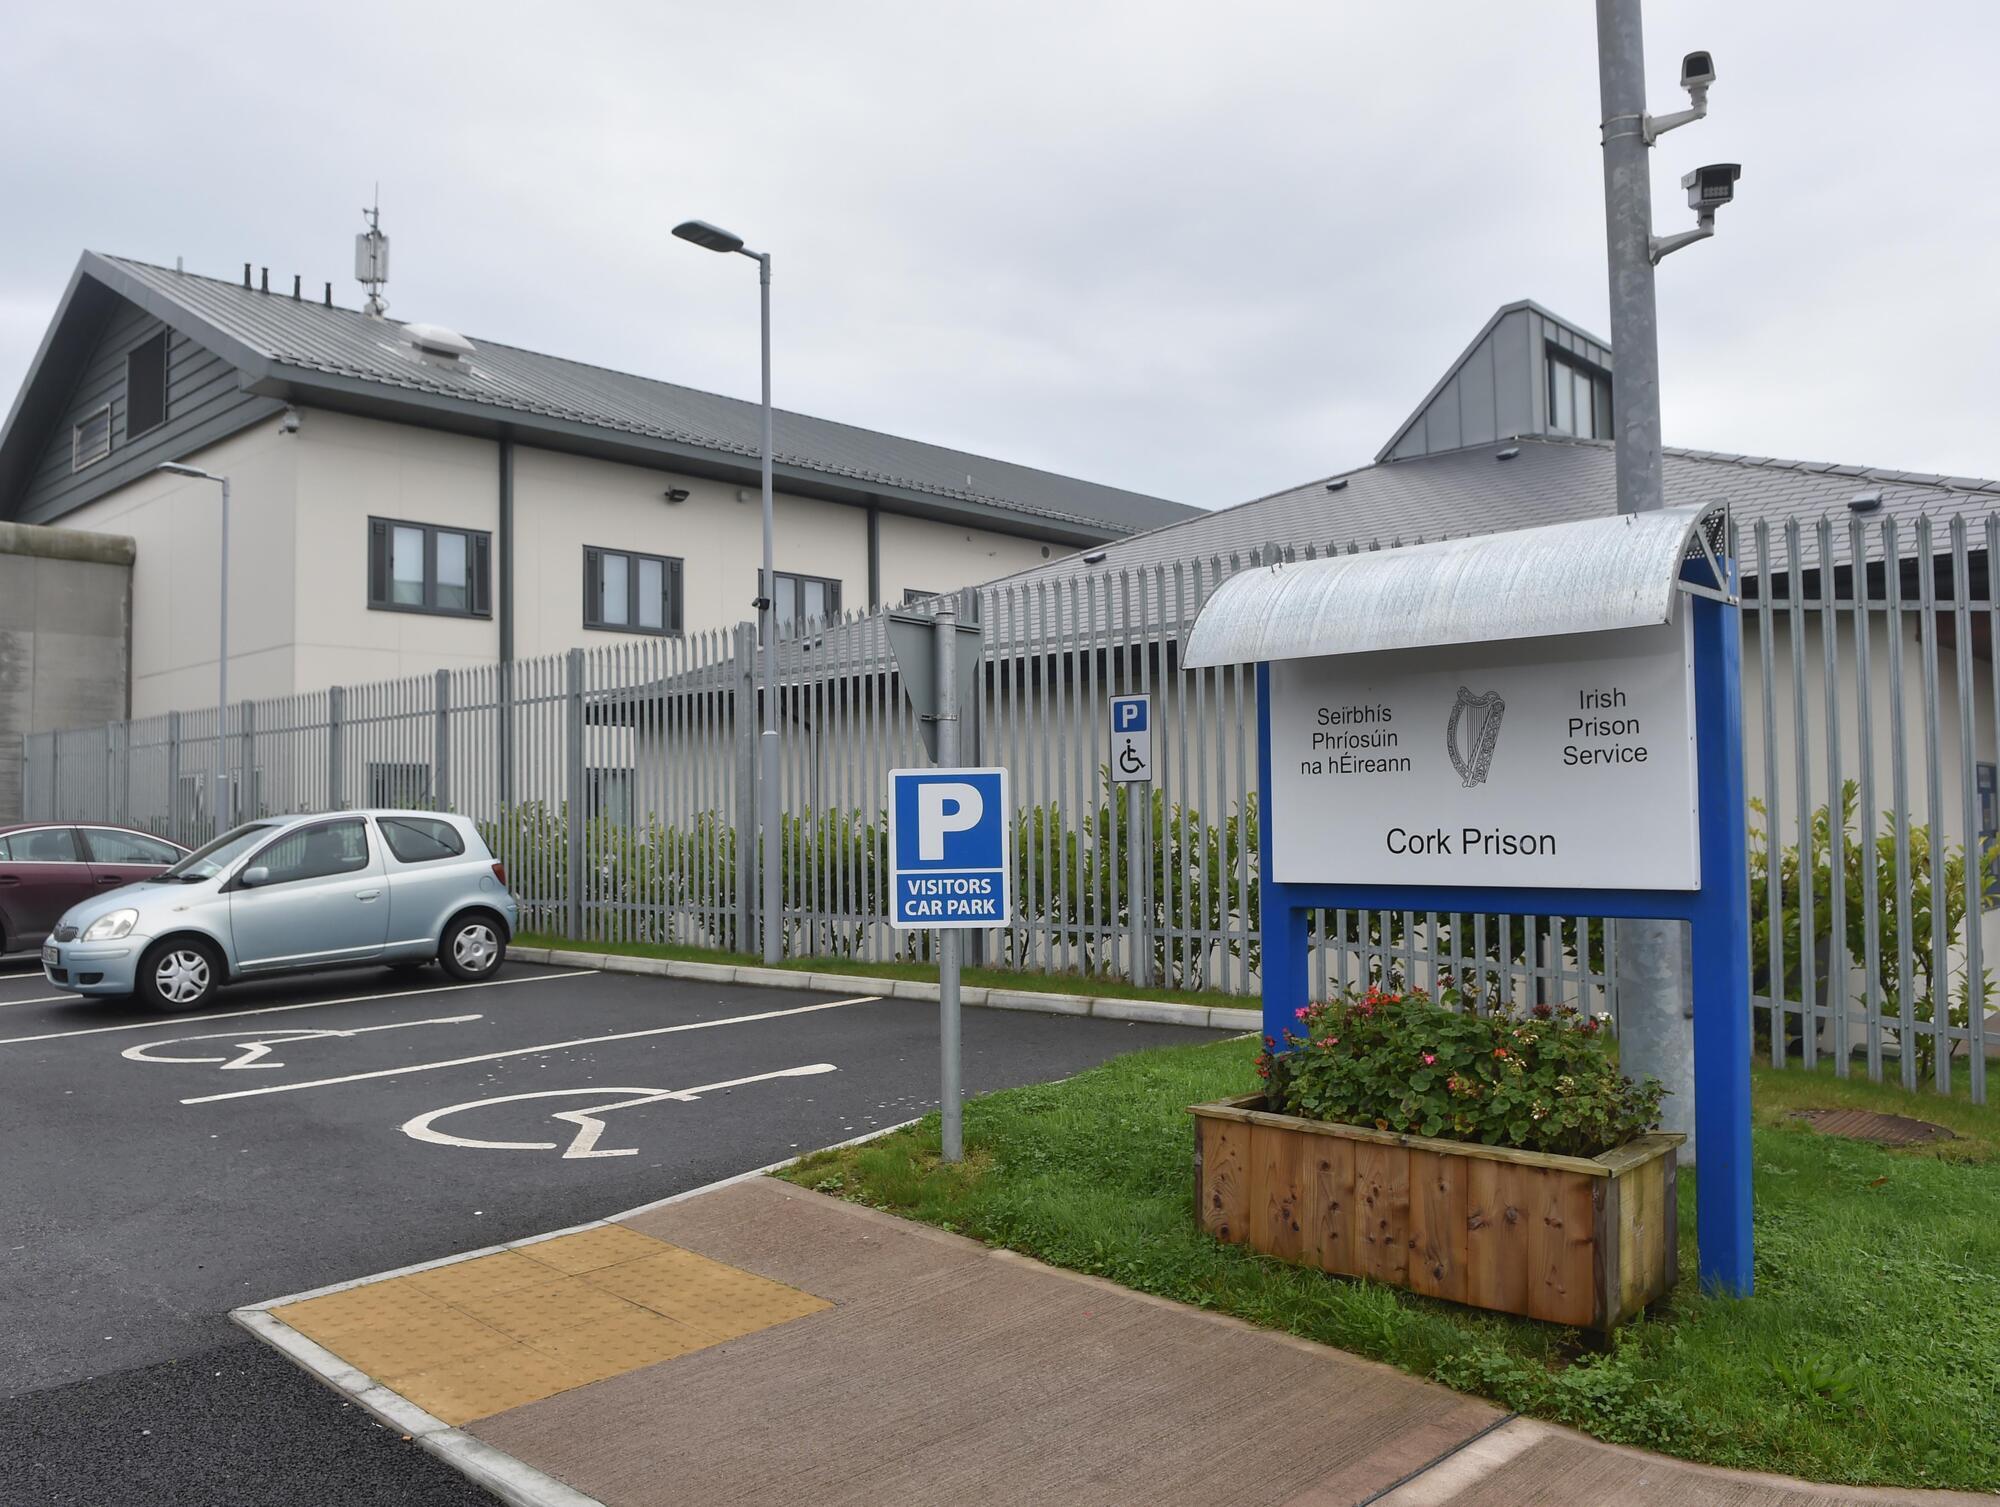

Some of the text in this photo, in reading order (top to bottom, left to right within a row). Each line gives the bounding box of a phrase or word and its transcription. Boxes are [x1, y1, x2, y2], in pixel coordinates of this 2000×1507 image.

[1580, 687, 1626, 710] Irish
[1122, 704, 1138, 729] P
[1317, 703, 1392, 725] Seirbhís
[1568, 716, 1640, 738] Prison
[1312, 729, 1398, 750] Phríosúin
[1301, 751, 1411, 775] na hÉireann
[1563, 743, 1648, 766] Service
[917, 782, 984, 861] P
[1386, 827, 1556, 856] Cork Prison
[907, 878, 992, 895] VISITORS
[904, 898, 996, 917] CAR PARK
